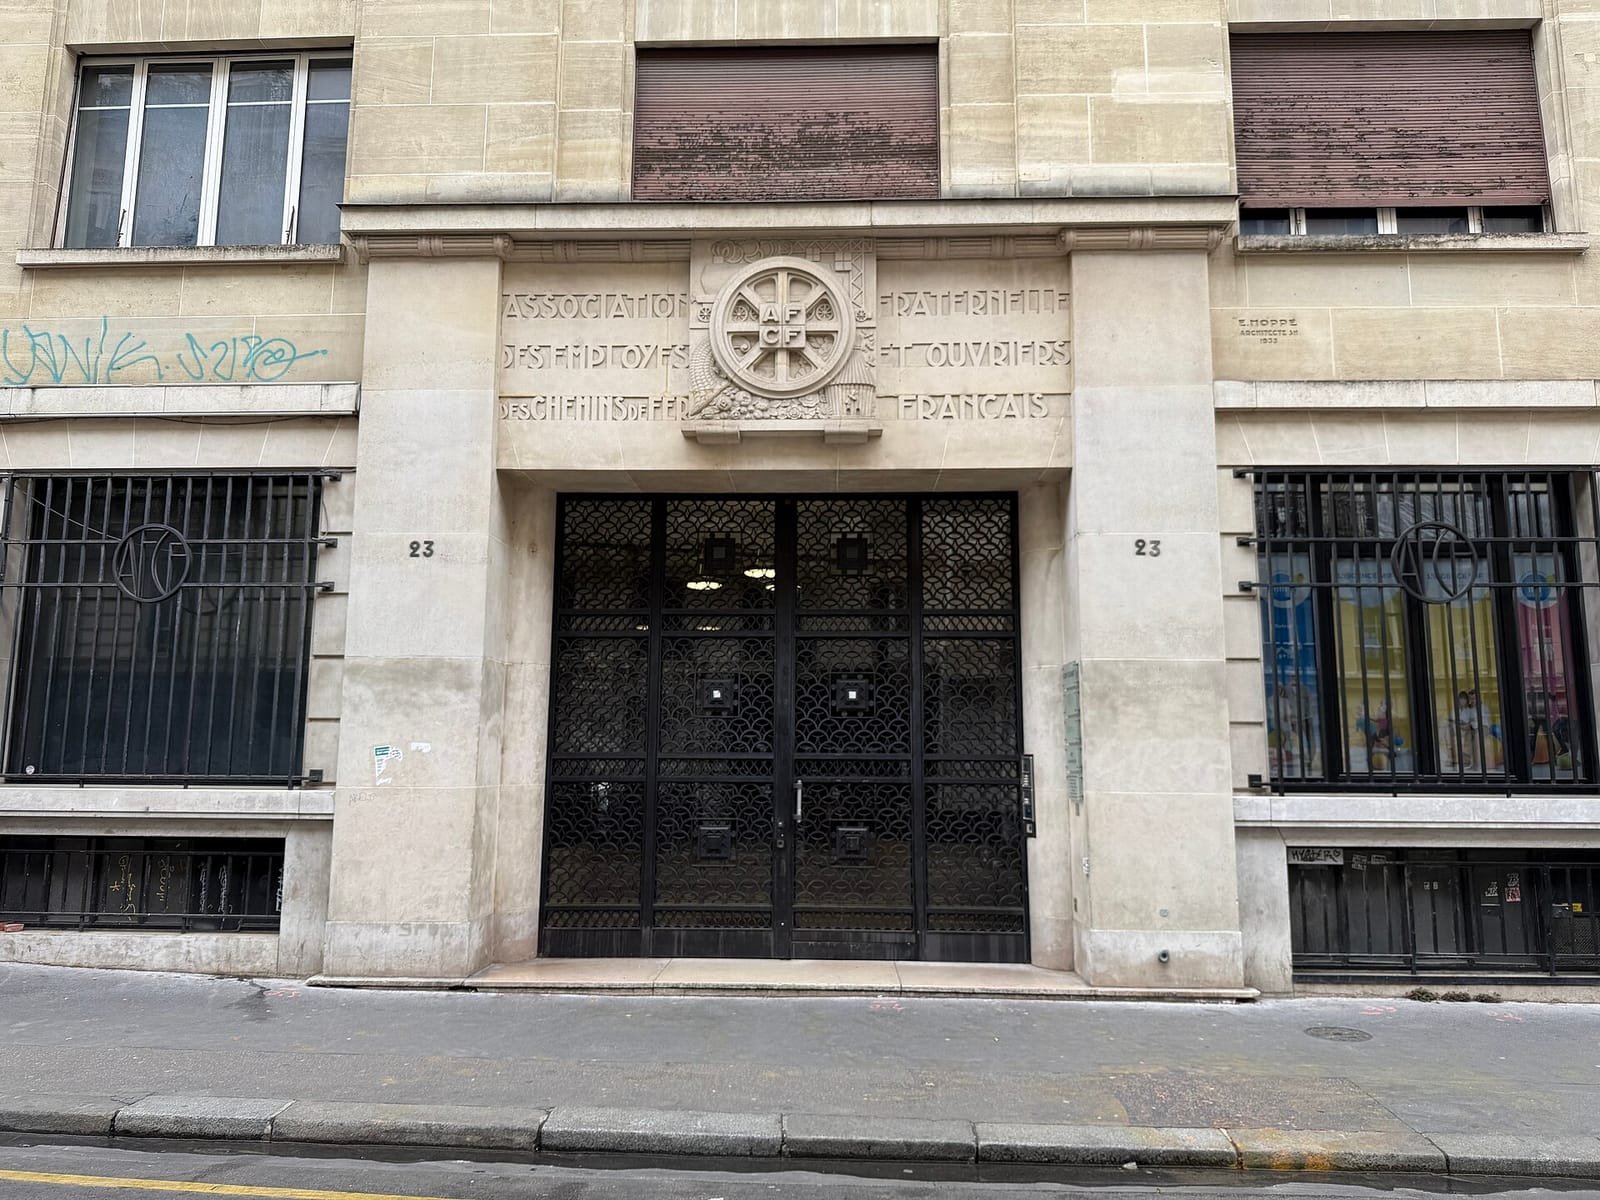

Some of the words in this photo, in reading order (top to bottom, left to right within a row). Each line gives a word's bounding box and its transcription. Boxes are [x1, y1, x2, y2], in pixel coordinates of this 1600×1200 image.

[503, 293, 690, 319] ASSOCIATION
[877, 290, 1071, 317] FRATERNELLE
[502, 344, 545, 370] DES
[877, 343, 912, 368] ET
[925, 340, 1072, 367] OUVRIERS
[531, 395, 628, 421] CHEMINS
[409, 540, 434, 558] 23
[1134, 538, 1161, 558] 23
